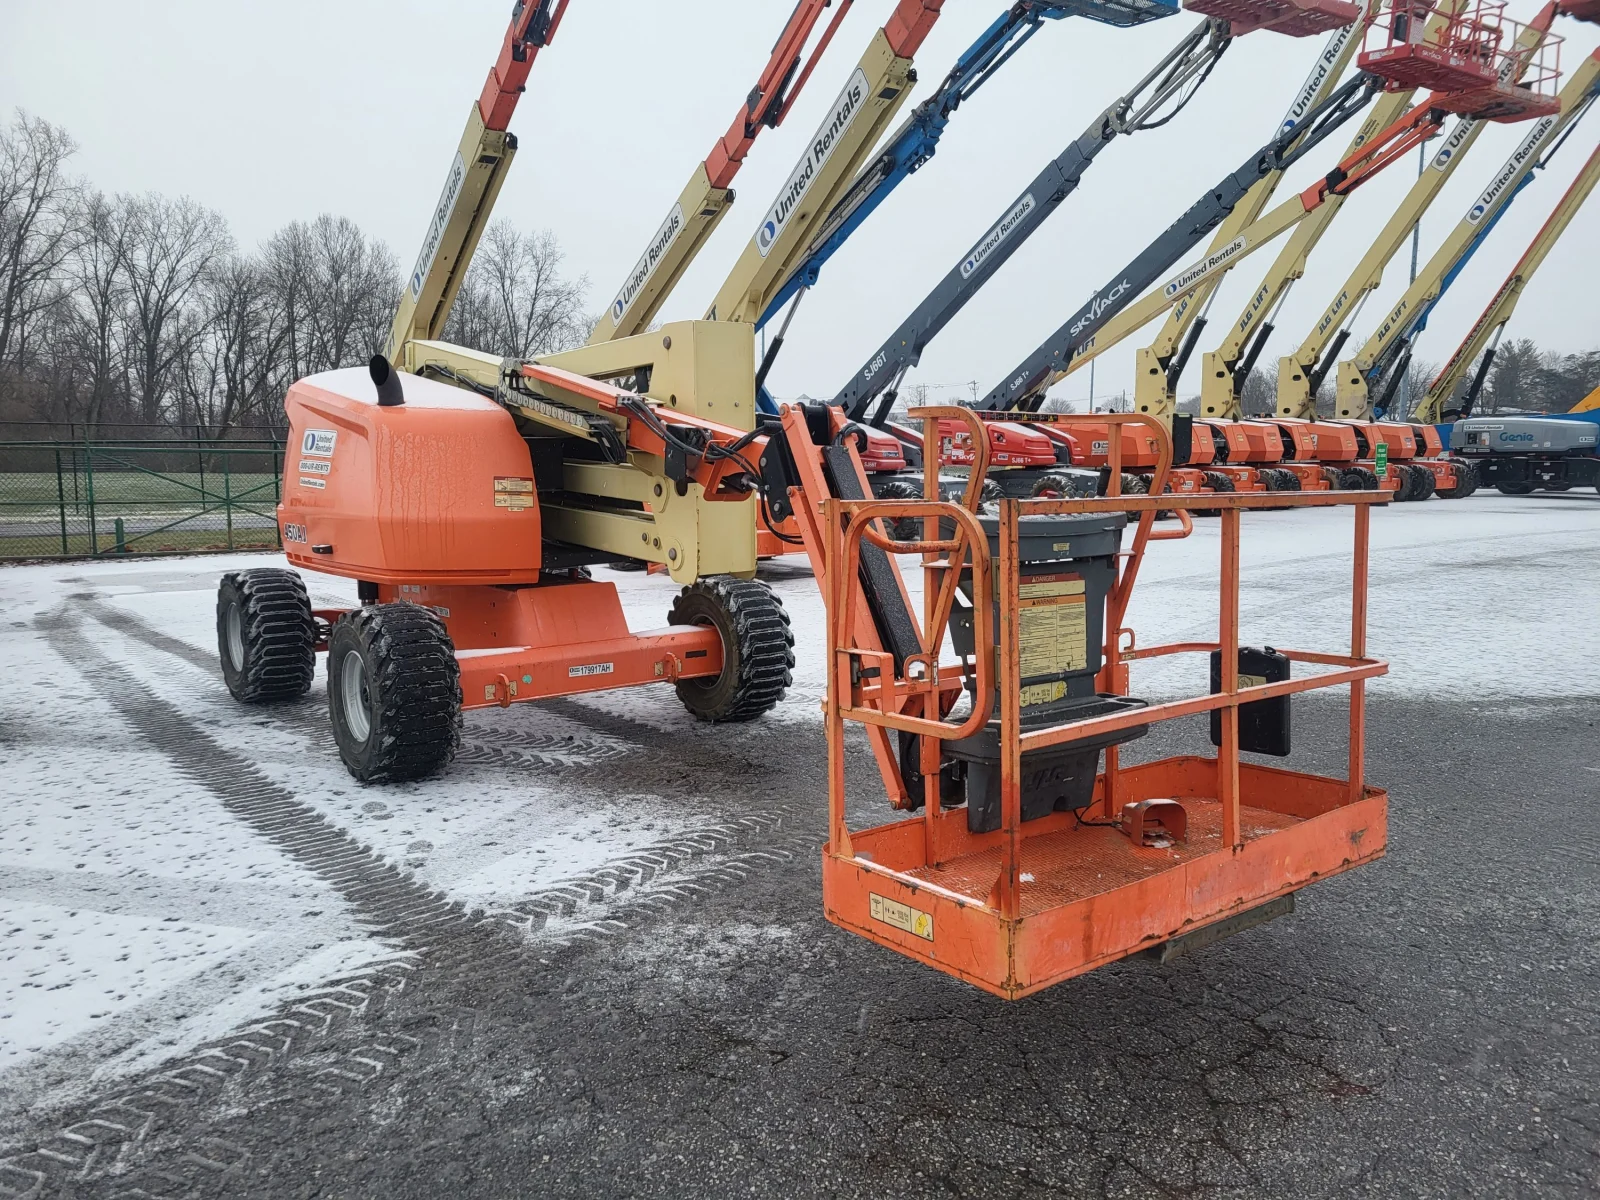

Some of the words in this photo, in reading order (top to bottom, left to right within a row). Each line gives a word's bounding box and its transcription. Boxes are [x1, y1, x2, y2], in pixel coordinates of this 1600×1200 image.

[1293, 65, 1327, 118] United
[774, 162, 814, 224] United
[813, 84, 861, 164] Rentals
[1449, 119, 1475, 148] Unit
[1483, 163, 1516, 205] United
[1514, 118, 1553, 165] Rentals
[419, 223, 439, 277] United
[437, 166, 462, 225] Rentals
[974, 232, 1000, 263] United
[1000, 201, 1030, 236] Rentals
[623, 259, 649, 305] United
[648, 216, 680, 266] Rentals
[1178, 263, 1207, 288] United
[1209, 241, 1242, 268] Rentals
[1069, 278, 1131, 337] SKYJACK
[1175, 299, 1188, 322] JLG
[1240, 310, 1253, 333] JLG
[1252, 284, 1268, 311] LIFT
[1318, 314, 1332, 336] JLG
[1331, 290, 1348, 316] LIFT
[1377, 322, 1391, 342] JLG
[1390, 300, 1407, 324] LIFT
[864, 350, 887, 381] SJ66T
[1075, 336, 1096, 357] LIFT
[1010, 375, 1023, 391] SJ66
[314, 444, 332, 453] Rentals
[316, 434, 333, 443] United
[1500, 432, 1534, 442] Genie
[1035, 597, 1058, 605] WARNING
[581, 663, 611, 675] 179917AH
